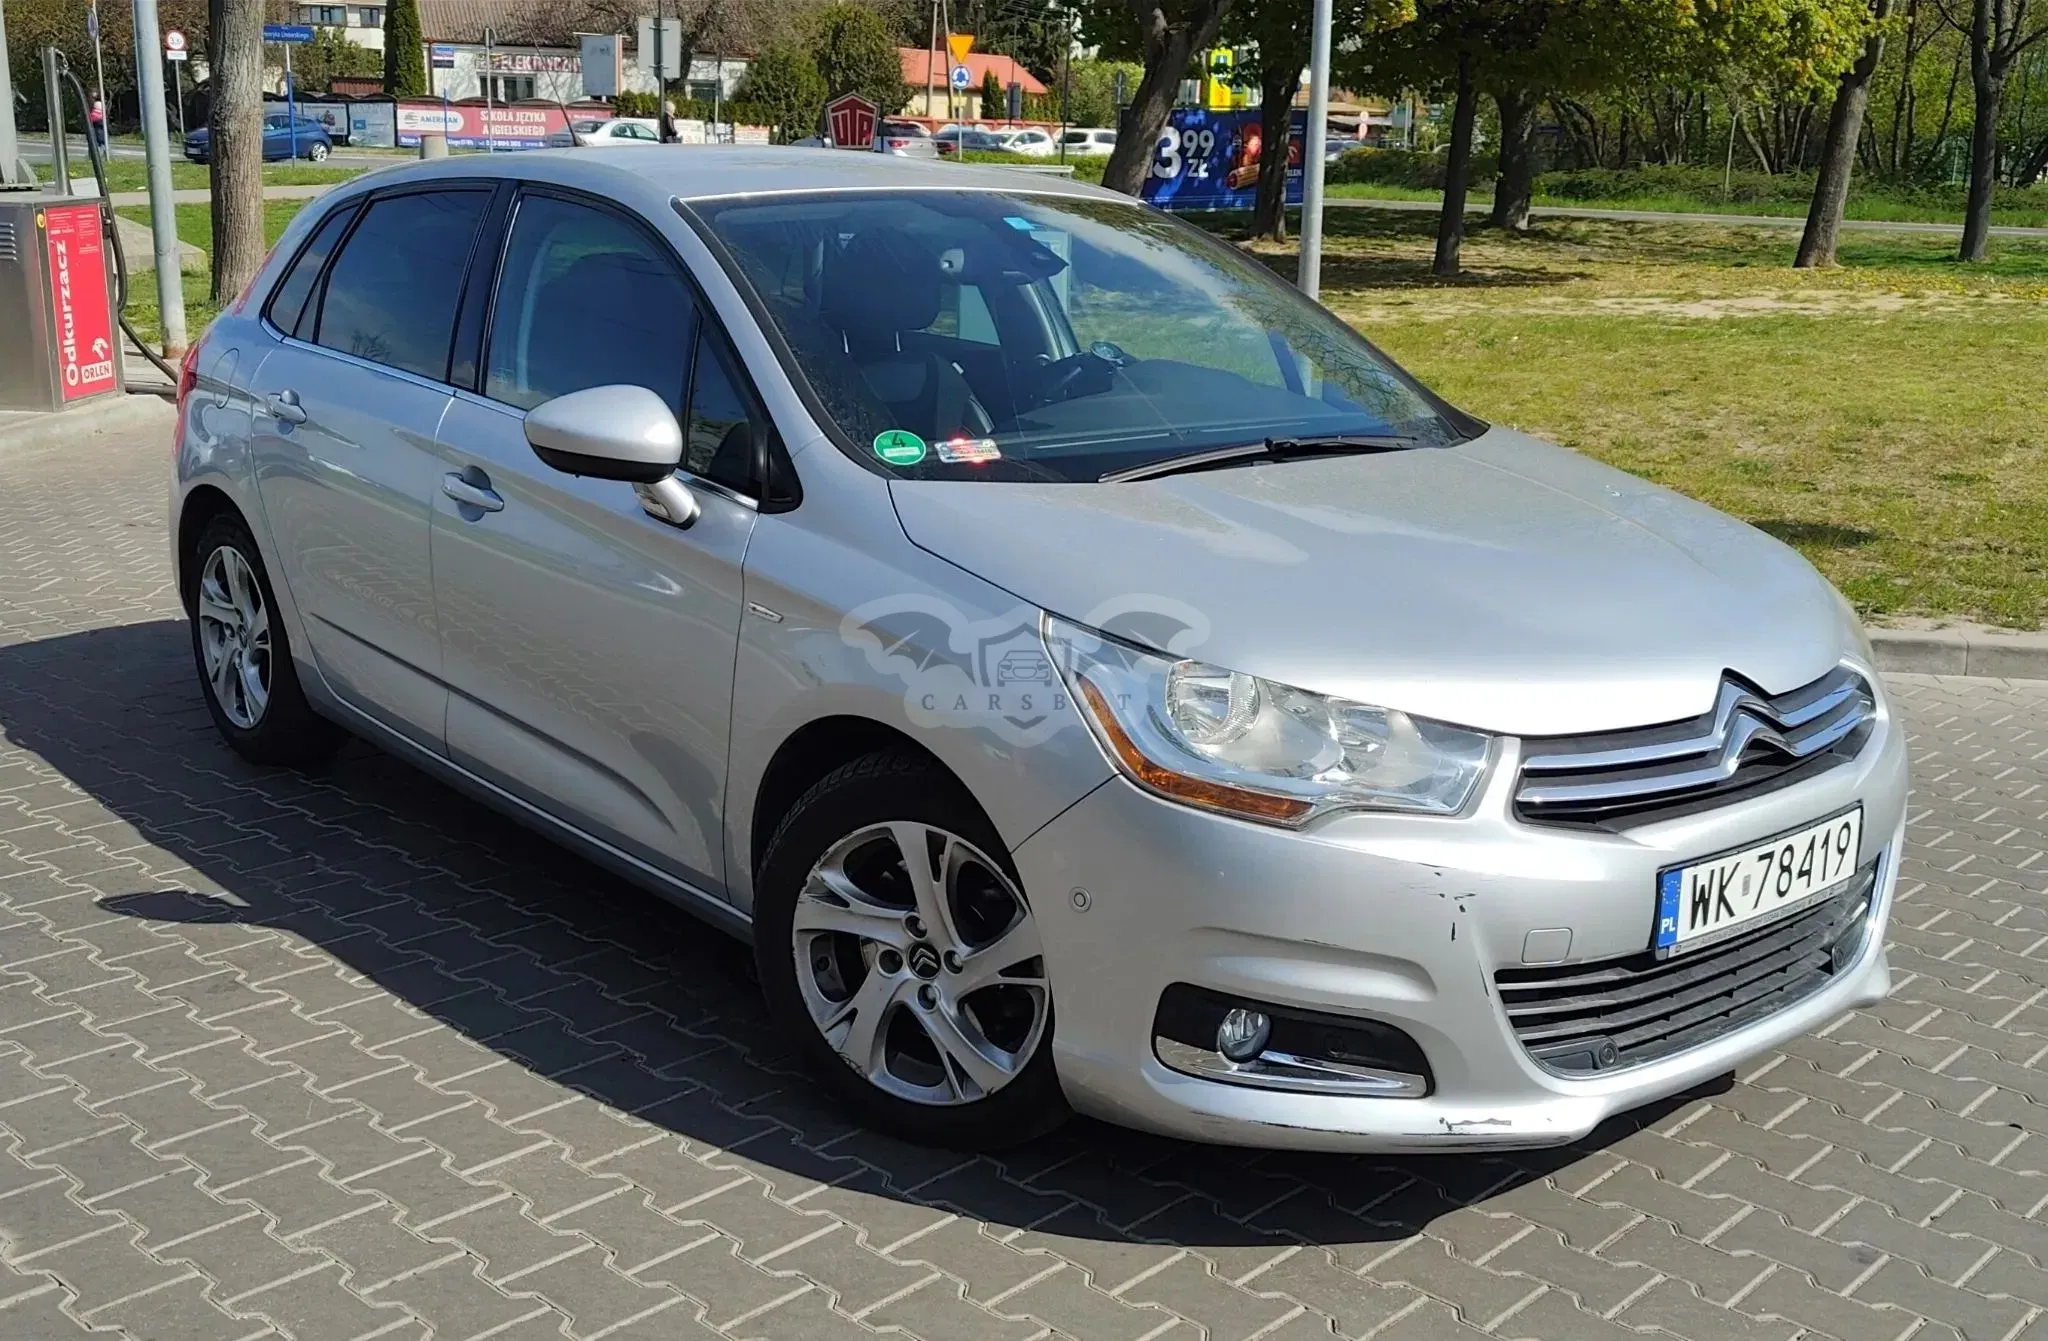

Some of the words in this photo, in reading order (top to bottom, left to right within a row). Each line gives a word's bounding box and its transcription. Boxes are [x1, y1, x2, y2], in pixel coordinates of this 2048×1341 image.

[515, 111, 546, 124] JĘZYKA
[1182, 130, 1215, 157] 99
[1187, 158, 1209, 178] ZŁ
[56, 239, 80, 387] Odkurzacz
[83, 364, 110, 379] ORLEN
[1690, 861, 1741, 930] WK
[1752, 821, 1851, 910] 78419
[1661, 916, 1676, 934] PL
